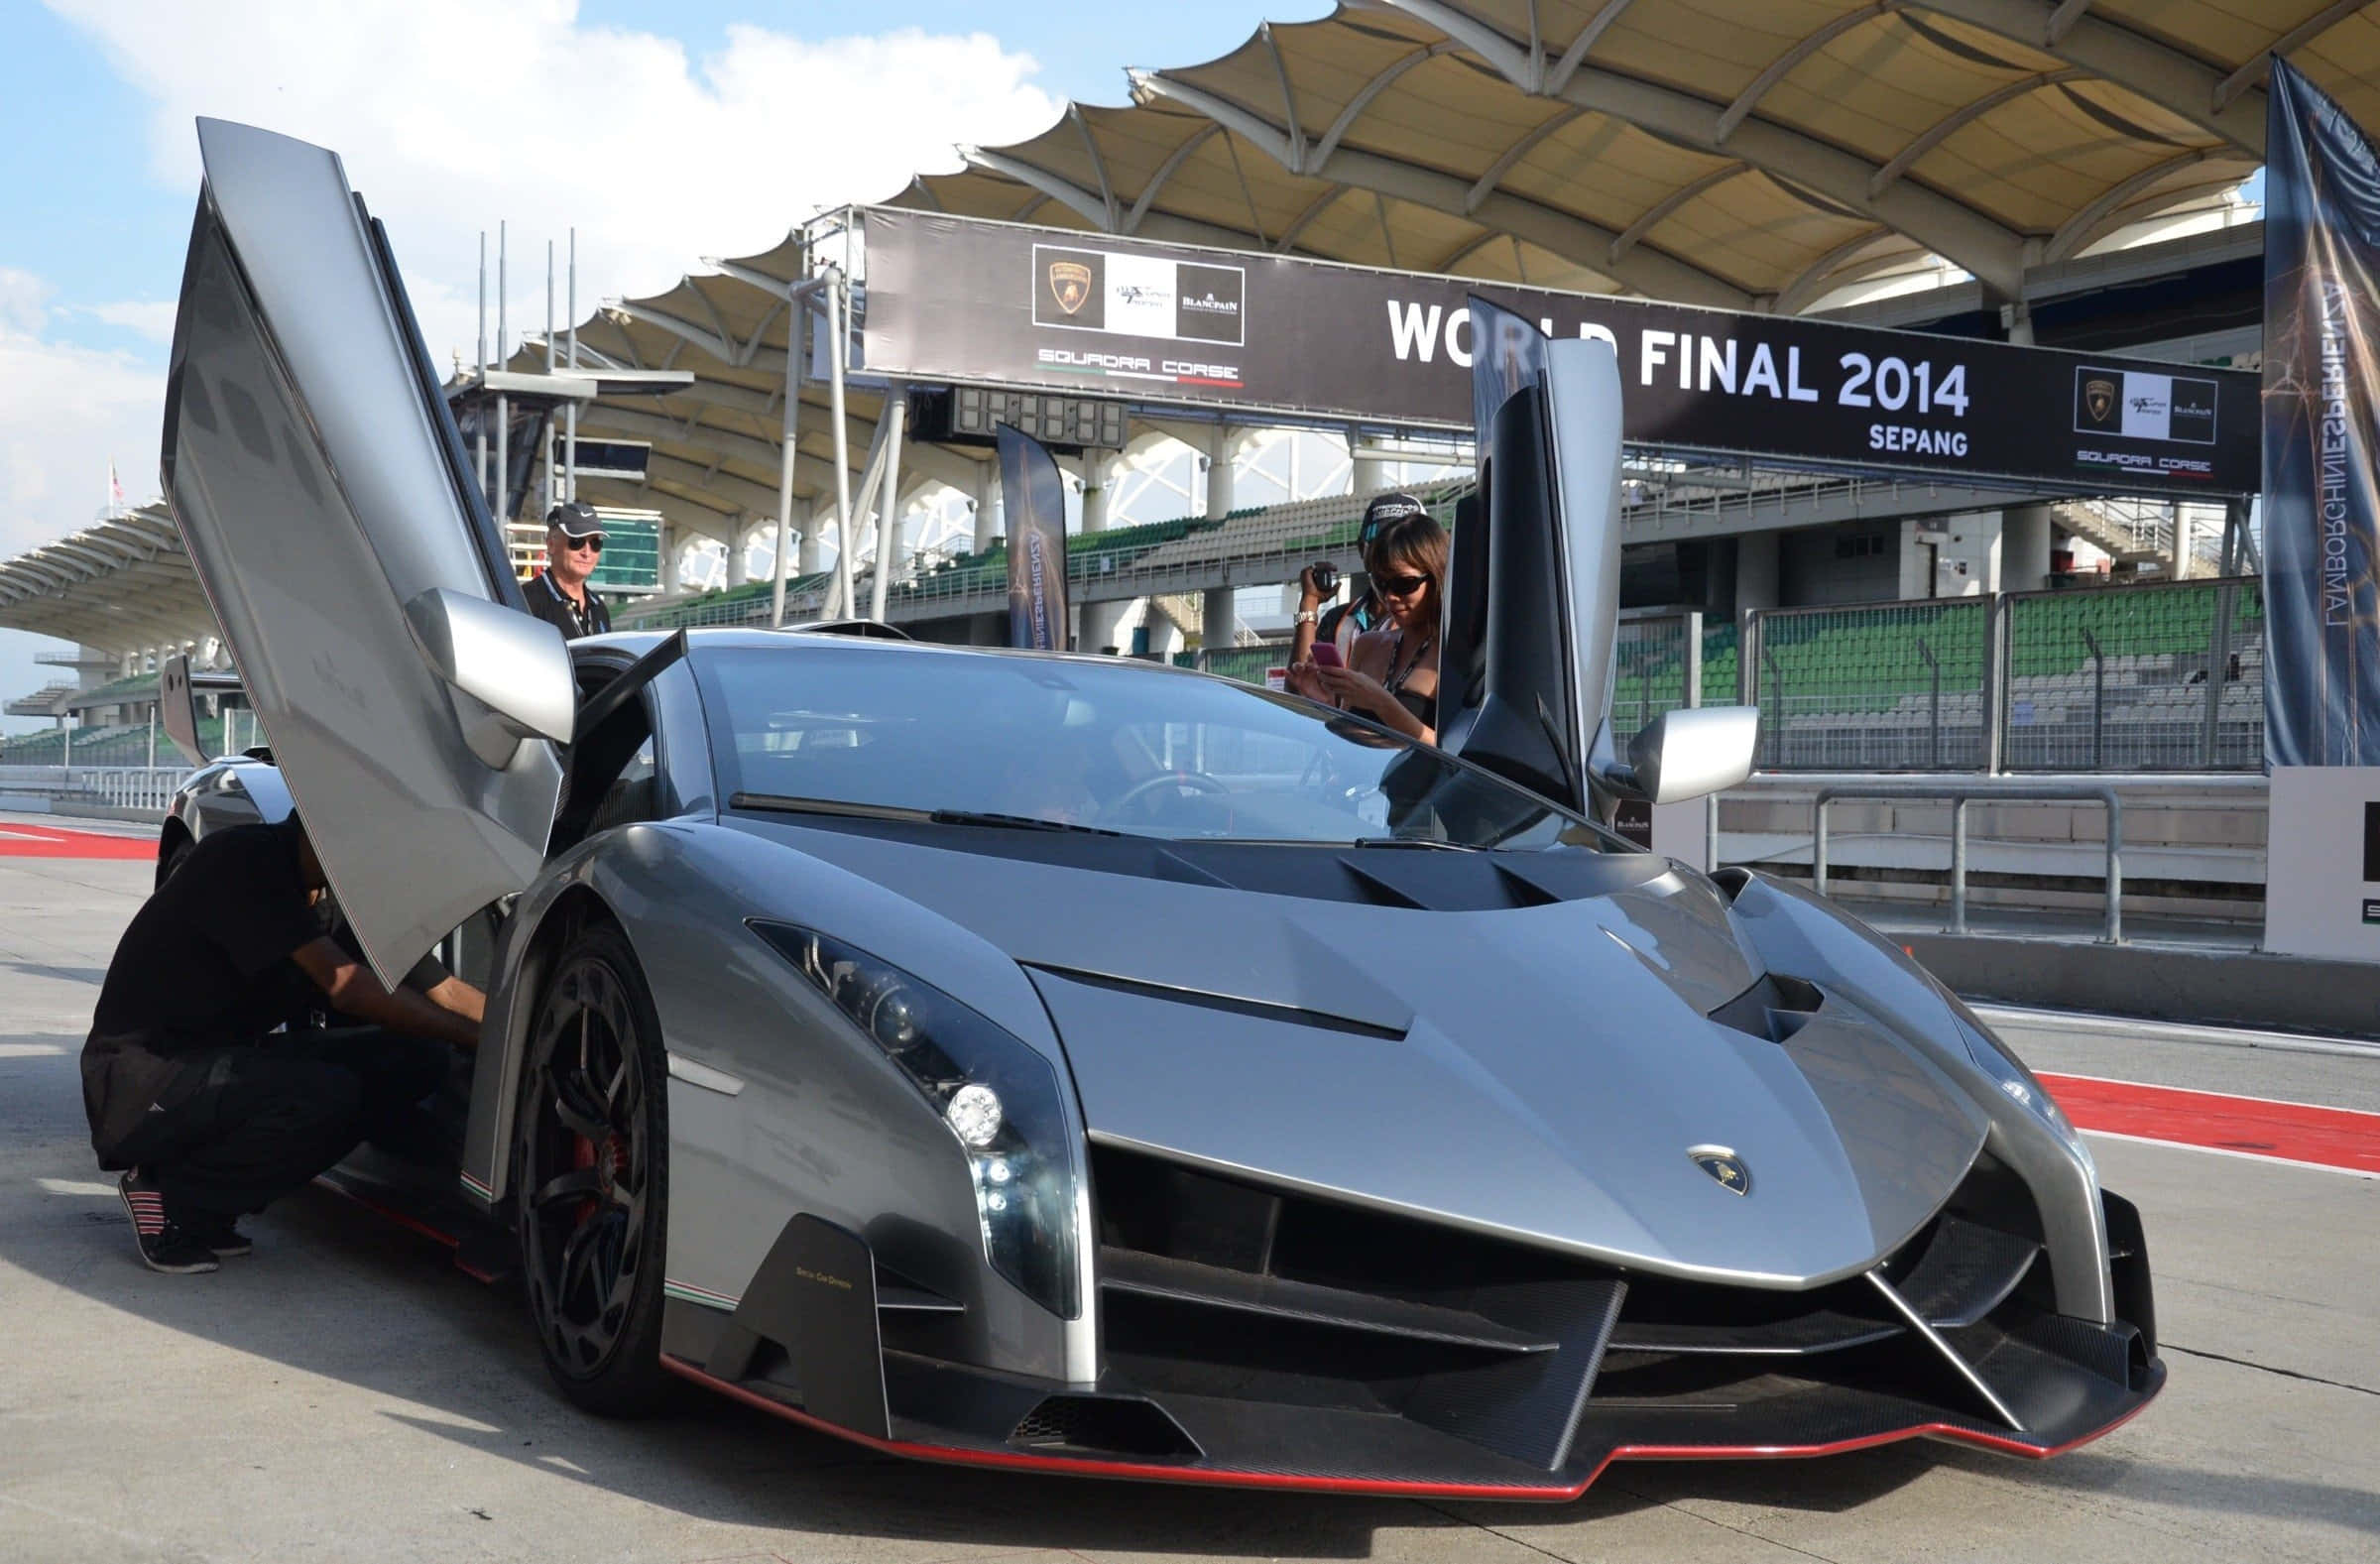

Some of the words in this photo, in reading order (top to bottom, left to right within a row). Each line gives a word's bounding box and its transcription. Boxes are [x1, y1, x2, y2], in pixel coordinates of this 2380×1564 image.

[1182, 296, 1238, 311] BLANCPAIN
[1038, 348, 1150, 372] SQUADRA
[1162, 360, 1239, 380] CORSE
[1387, 300, 1617, 373] WOR
[1641, 329, 1819, 402] FINAL
[1839, 352, 1968, 417] 2014
[1869, 423, 1967, 456] SEPANG
[2077, 449, 2152, 467] SQUADRA
[2159, 458, 2211, 473] CORSE
